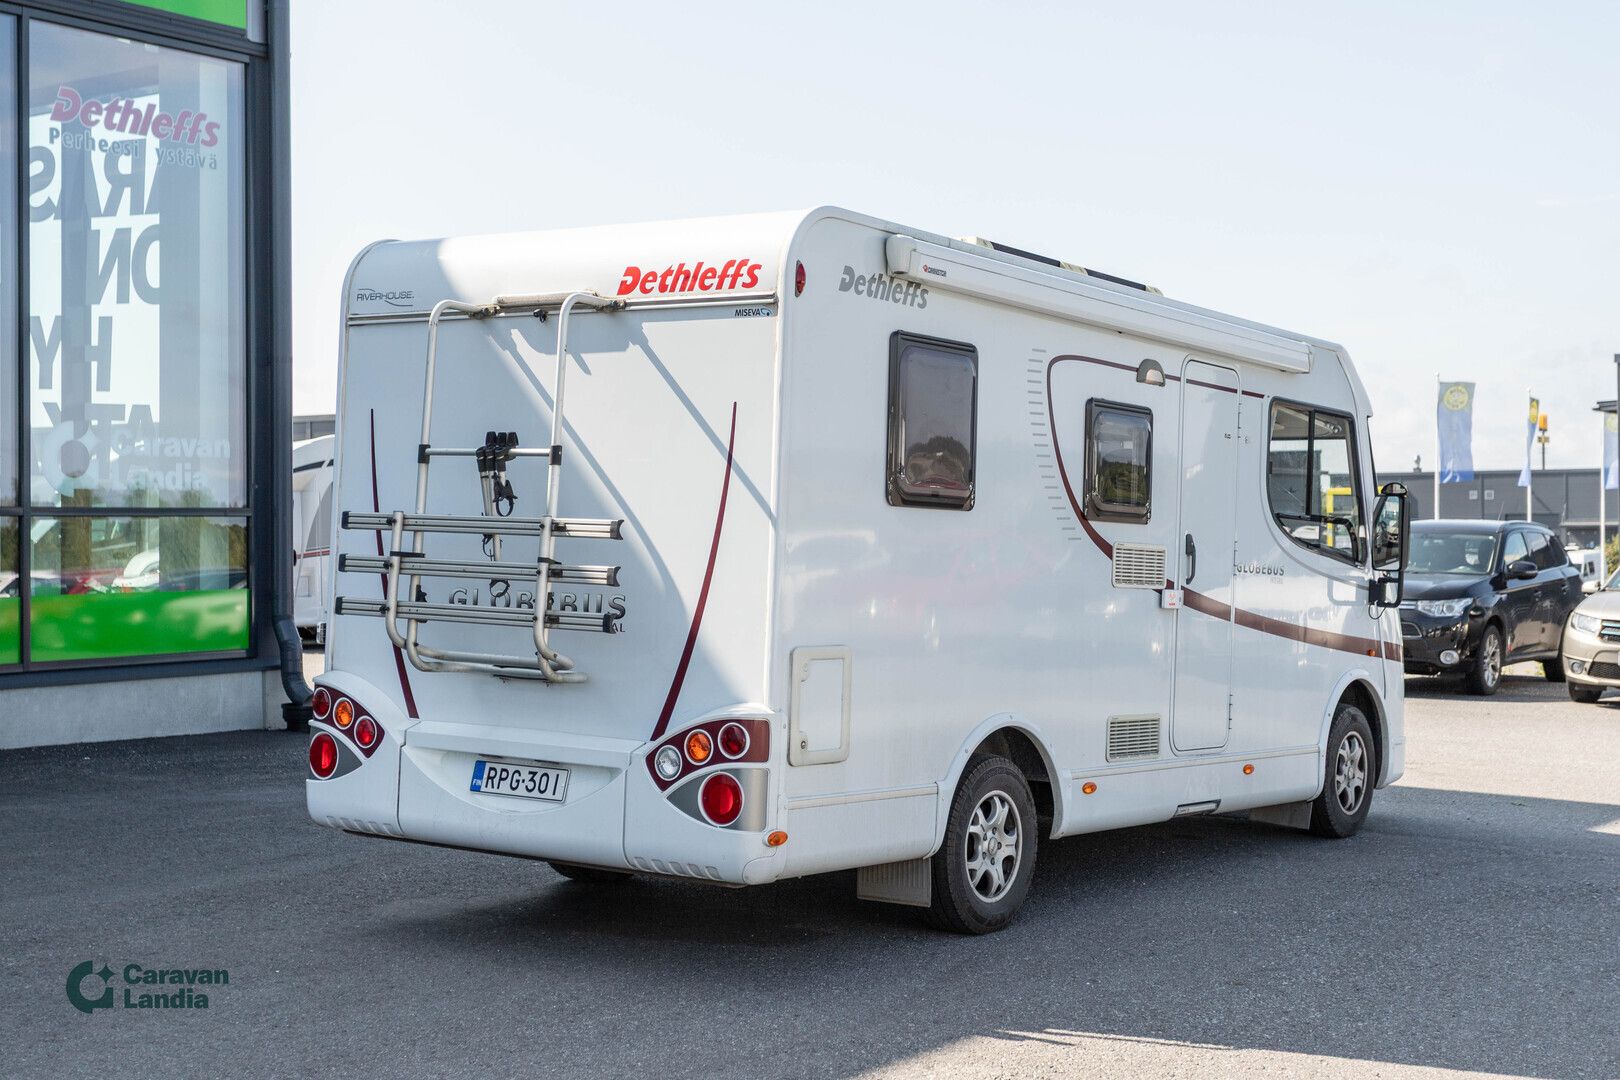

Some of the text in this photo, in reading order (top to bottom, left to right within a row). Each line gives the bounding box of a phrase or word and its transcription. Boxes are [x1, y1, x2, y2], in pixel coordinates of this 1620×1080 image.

[50, 86, 221, 147] Dethleffs
[48, 127, 217, 170] Perheesi ystävä
[617, 258, 763, 296] Dethleffs
[838, 265, 929, 310] Dethleffs
[735, 308, 761, 317] MISEVA
[485, 766, 560, 796] RPG-301
